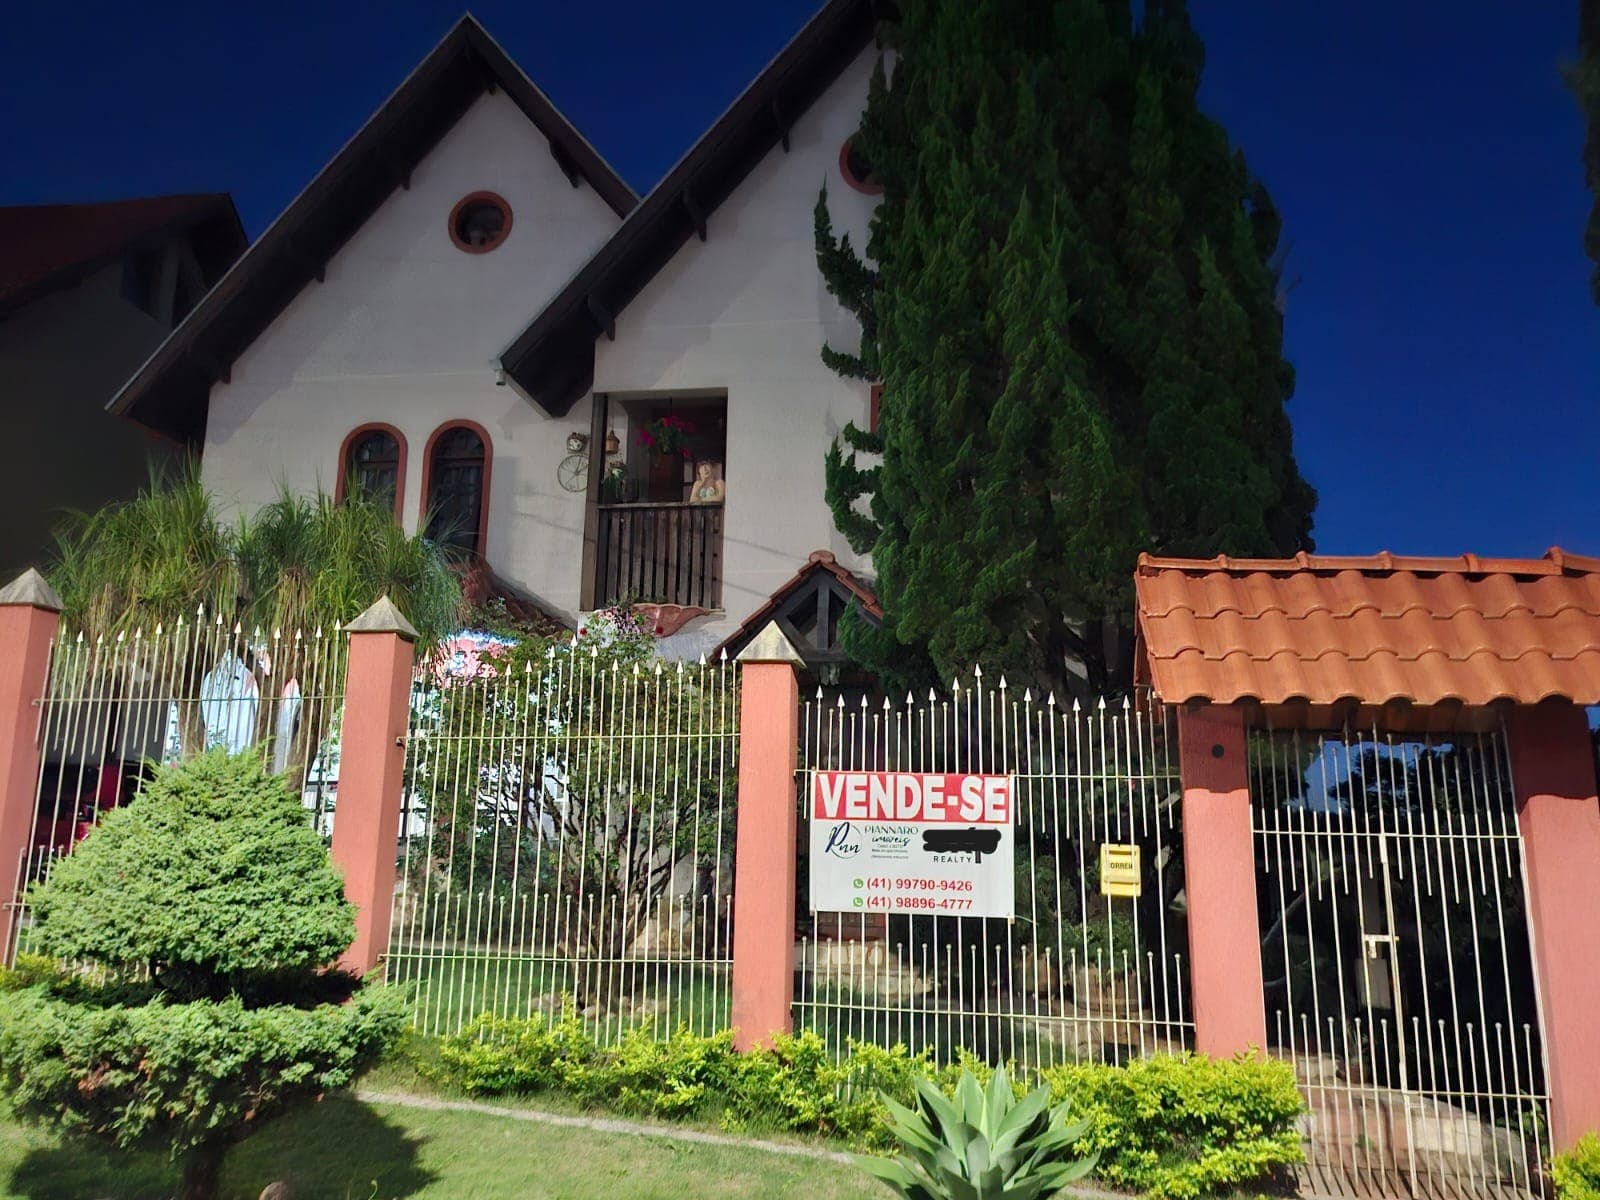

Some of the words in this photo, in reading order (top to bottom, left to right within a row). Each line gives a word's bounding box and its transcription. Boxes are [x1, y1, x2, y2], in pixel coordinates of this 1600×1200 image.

[818, 774, 1007, 821] VENDE-SE
[864, 825, 918, 835] PIANNARO
[933, 855, 972, 863] REALTY
[867, 878, 892, 891] (41)
[895, 878, 973, 891] 99790-9426
[867, 896, 892, 909] (41)
[895, 897, 973, 909] 98896-4777
